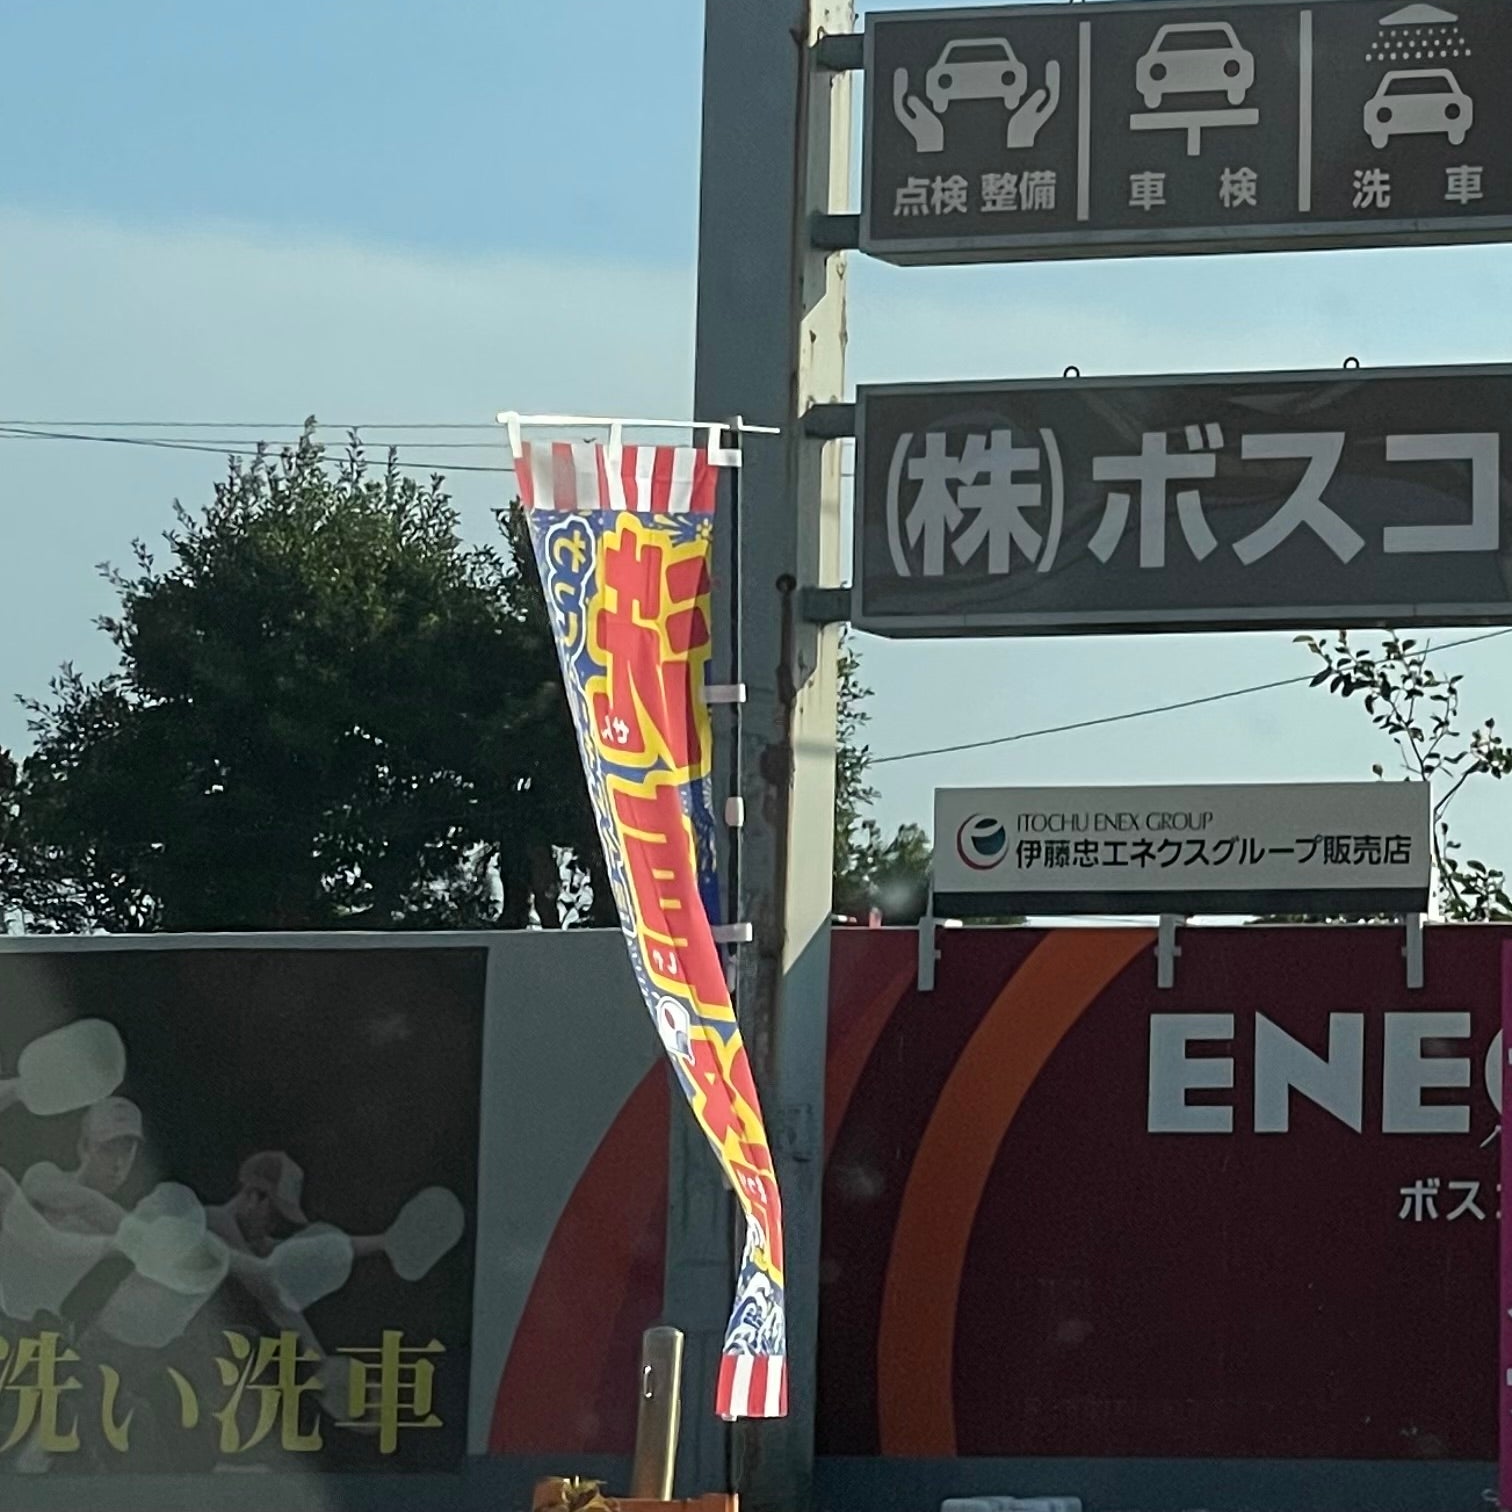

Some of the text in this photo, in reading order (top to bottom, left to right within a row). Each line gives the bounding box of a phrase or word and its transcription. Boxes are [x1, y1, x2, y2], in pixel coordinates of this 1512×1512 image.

[893, 170, 1057, 217] 点検 整備
[1016, 811, 1213, 833] ITOCHU ENEX GROUP
[1015, 834, 1411, 869] 伊藤忠エネクスグループ販売店
[1147, 1010, 1502, 1134] ENE
[1399, 1177, 1501, 1222] ボス
[0, 1330, 447, 1455] 洗い洗車
